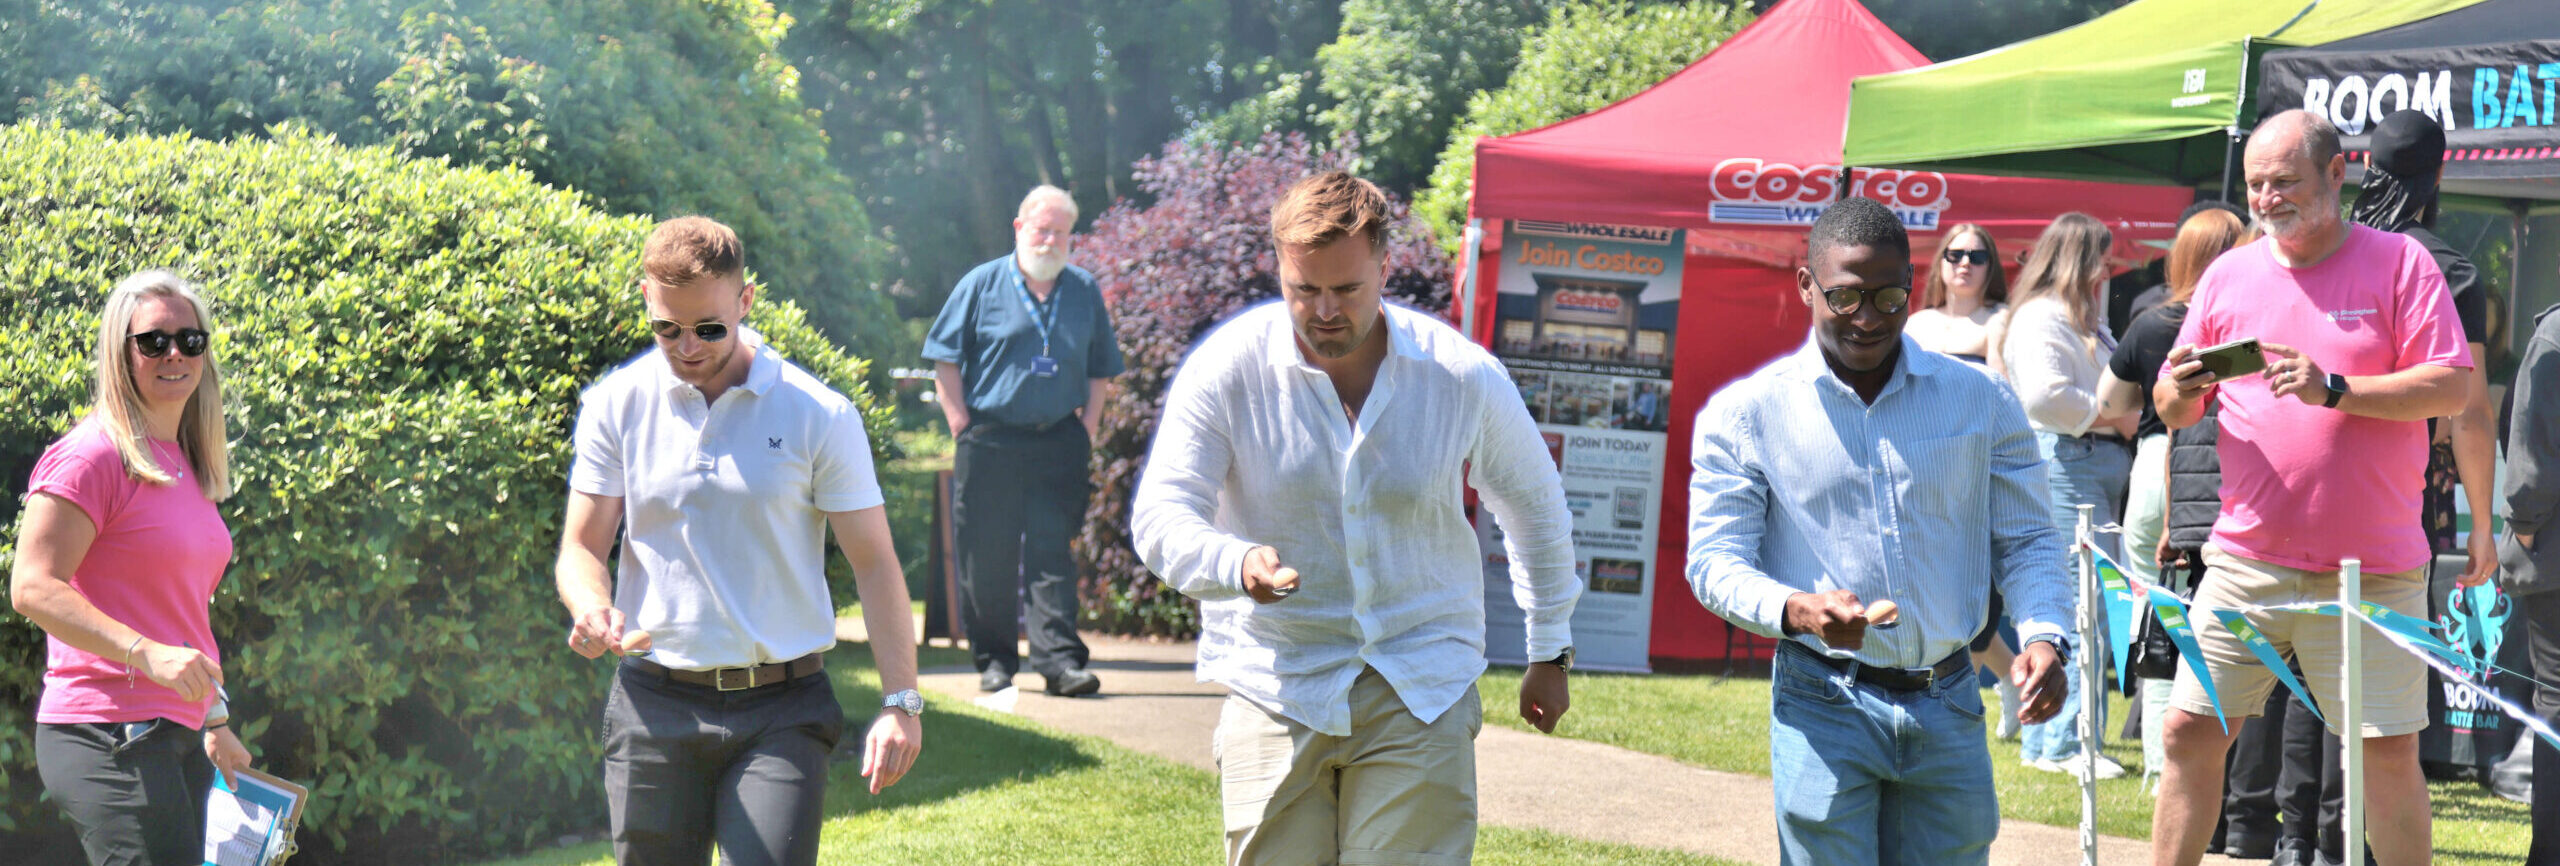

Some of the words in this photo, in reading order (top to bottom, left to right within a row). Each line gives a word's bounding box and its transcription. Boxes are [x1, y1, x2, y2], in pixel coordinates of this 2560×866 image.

[2303, 69, 2456, 136] BOOM
[1709, 158, 1949, 207] COSTCO
[1567, 223, 1668, 241] WHOLESALE
[1518, 241, 1570, 267] Join
[1577, 245, 1664, 275] Costco
[1568, 435, 1601, 448] JOIN
[1603, 437, 1652, 452] TODAY
[2443, 681, 2501, 712] BOOM
[2475, 713, 2500, 730] BAR
